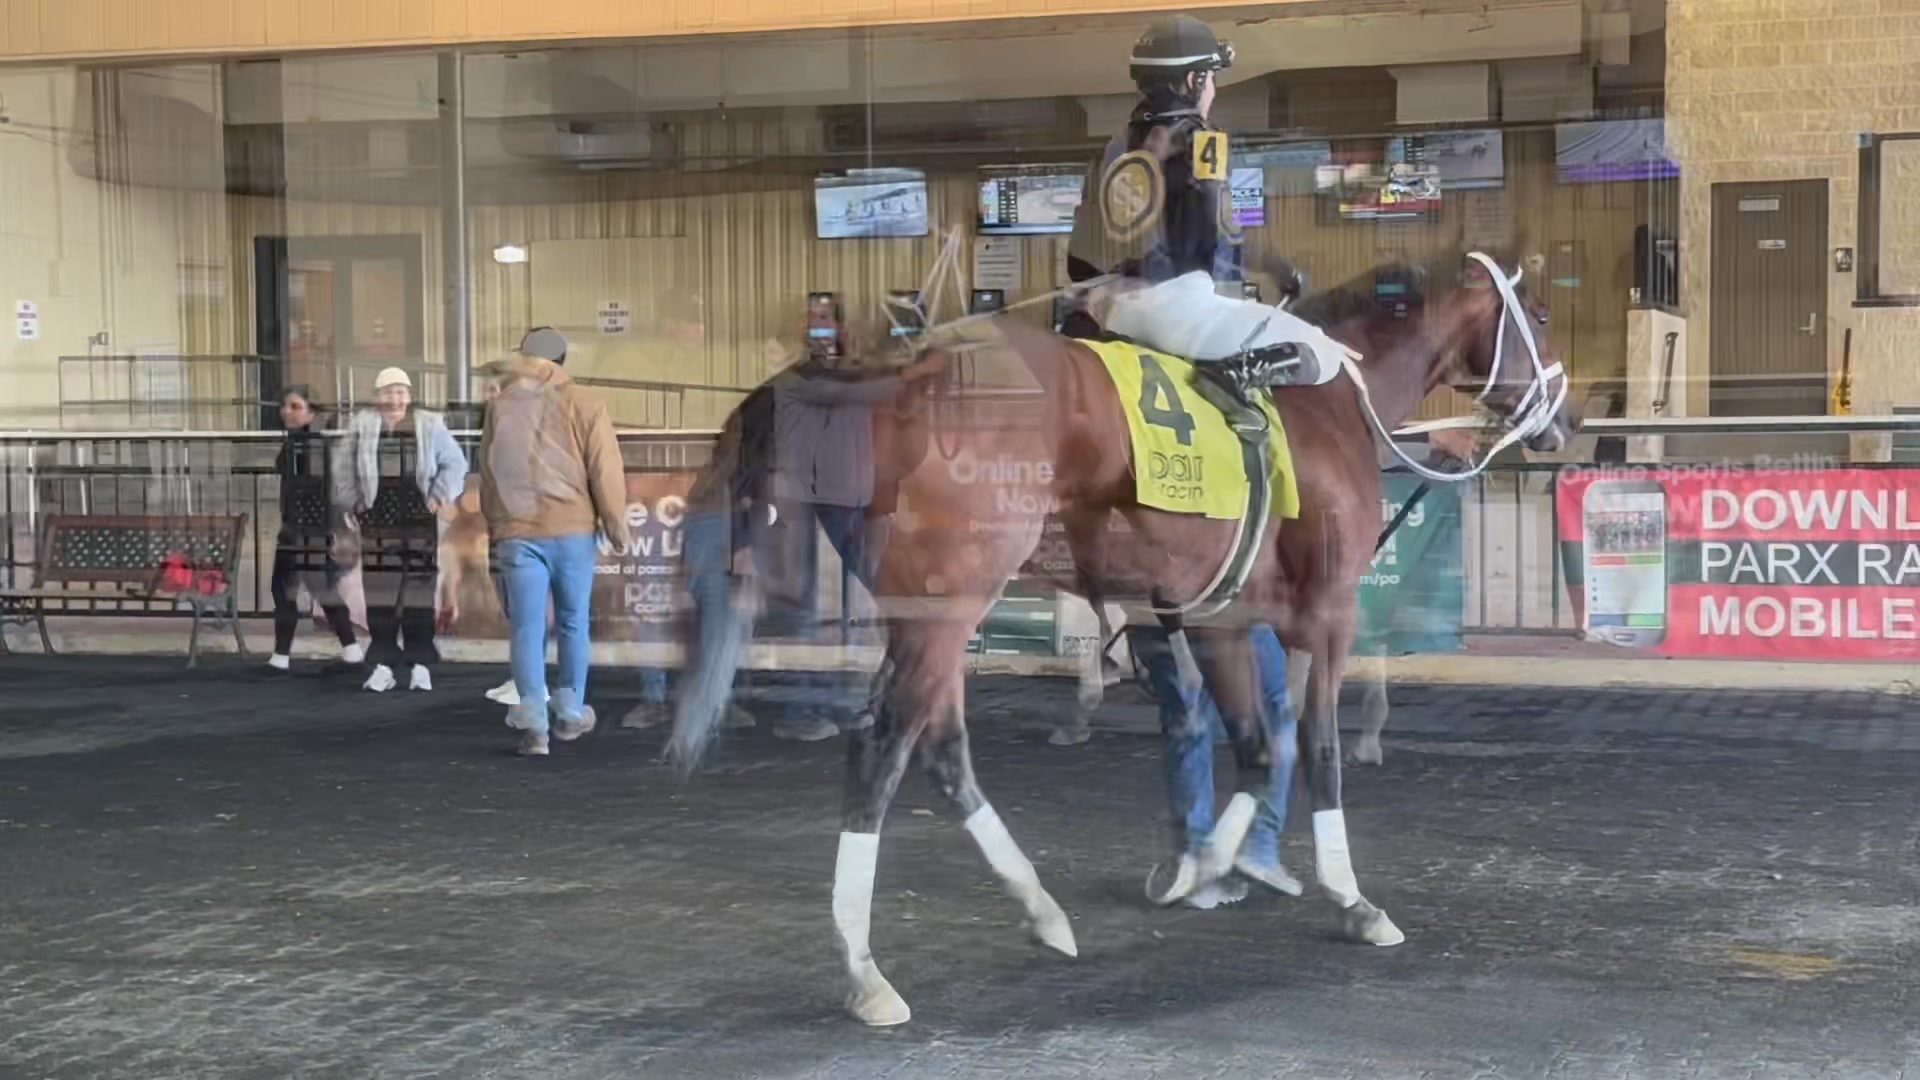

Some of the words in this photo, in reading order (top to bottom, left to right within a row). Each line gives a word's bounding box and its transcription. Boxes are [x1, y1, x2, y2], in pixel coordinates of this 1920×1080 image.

[1200, 136, 1218, 174] 4
[1138, 354, 1196, 447] 4
[950, 453, 1054, 484] Online
[1558, 462, 1649, 484] Online
[1655, 456, 1746, 487] Sports
[1702, 488, 1920, 530] DOWNL
[1701, 543, 1840, 585] PARX
[1858, 543, 1920, 585] RA
[1699, 596, 1917, 639] MOBILE
